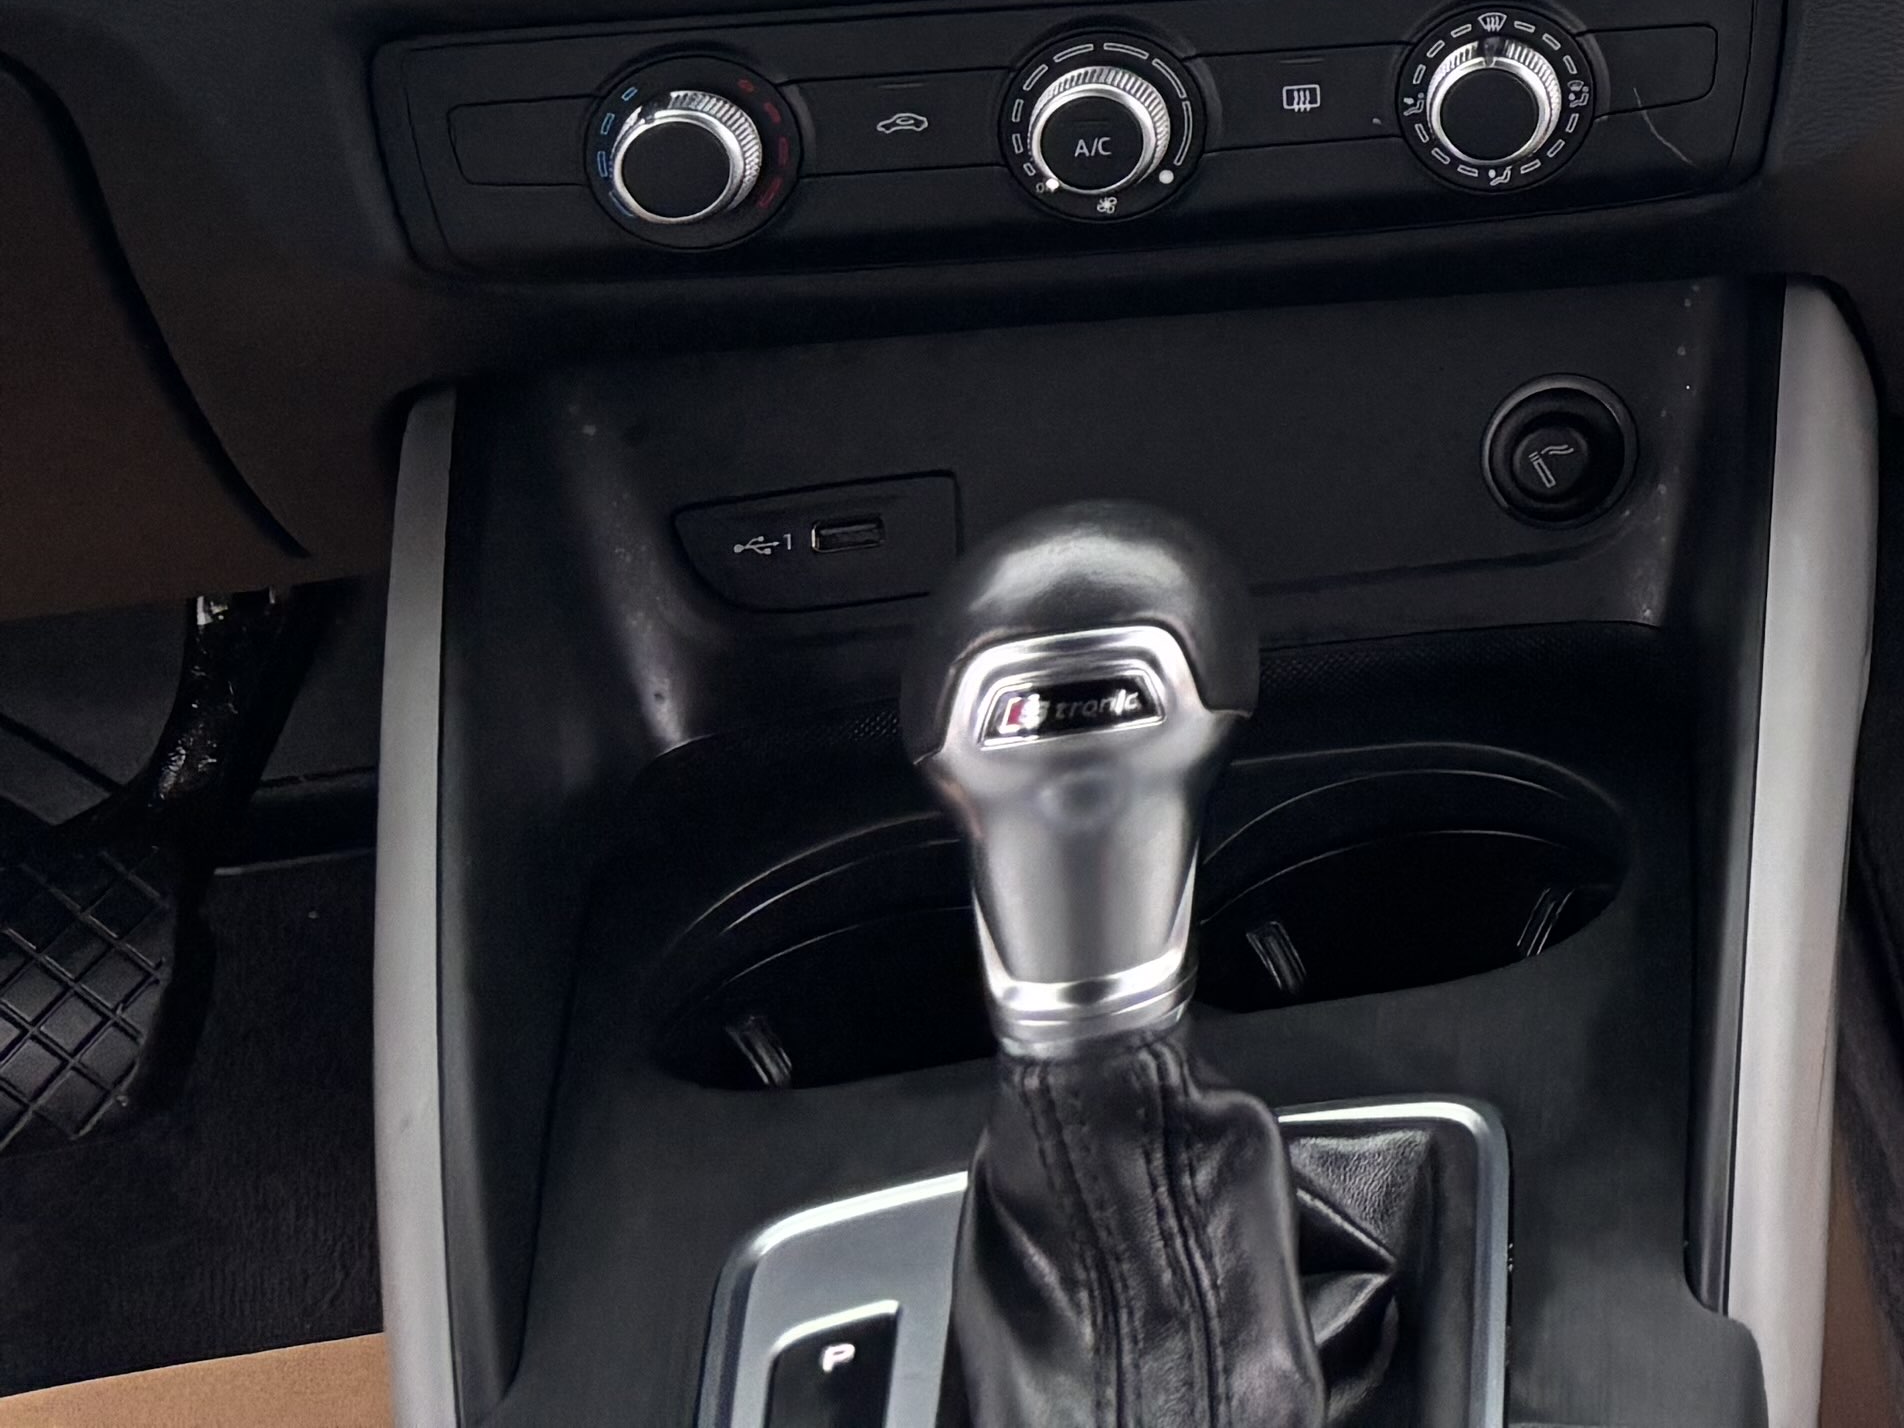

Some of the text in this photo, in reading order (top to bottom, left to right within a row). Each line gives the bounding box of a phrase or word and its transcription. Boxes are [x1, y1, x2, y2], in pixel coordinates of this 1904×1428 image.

[1073, 137, 1113, 158] A/C
[783, 533, 793, 551] 1
[820, 1342, 856, 1373] P
